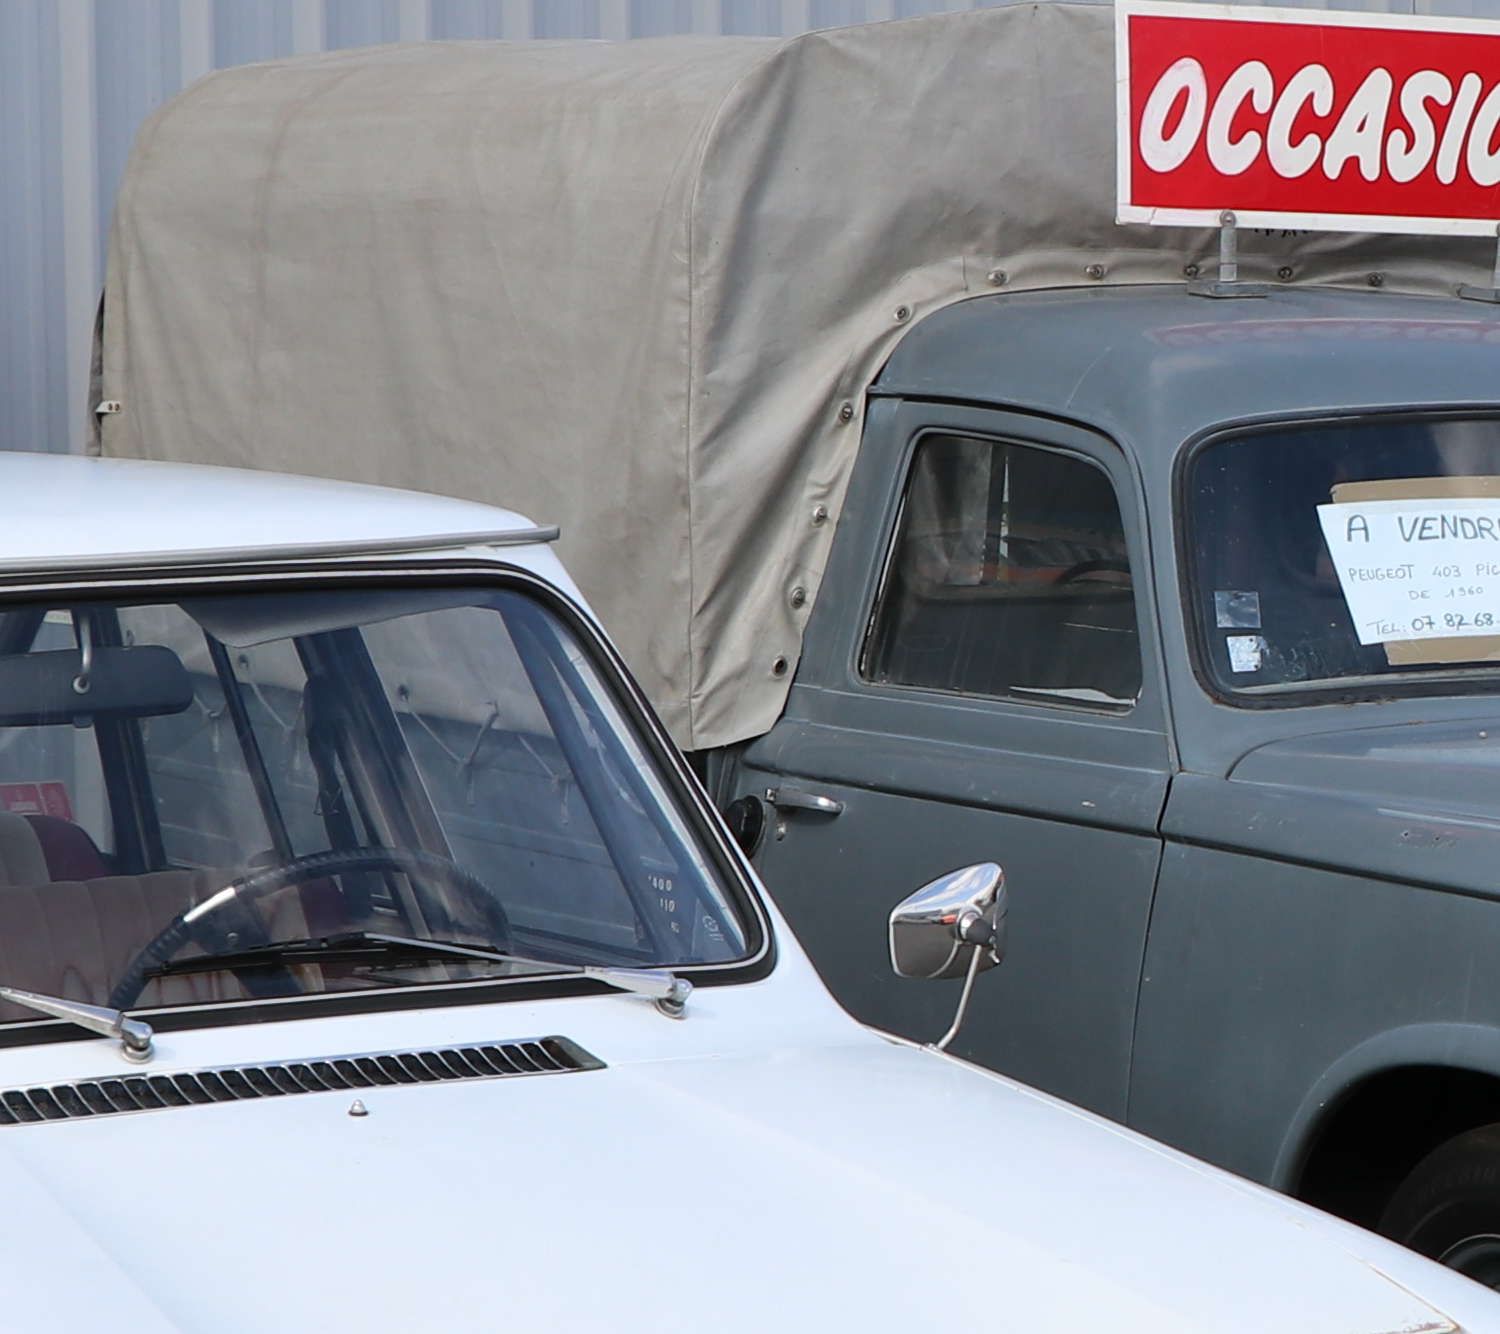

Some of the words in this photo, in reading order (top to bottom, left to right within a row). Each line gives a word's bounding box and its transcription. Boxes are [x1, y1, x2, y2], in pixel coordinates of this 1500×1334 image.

[1346, 514, 1369, 543] A
[1348, 564, 1415, 582] PEUGEOT
[1431, 565, 1462, 578] 403
[1408, 589, 1430, 601] DE
[1444, 586, 1483, 599] 1960
